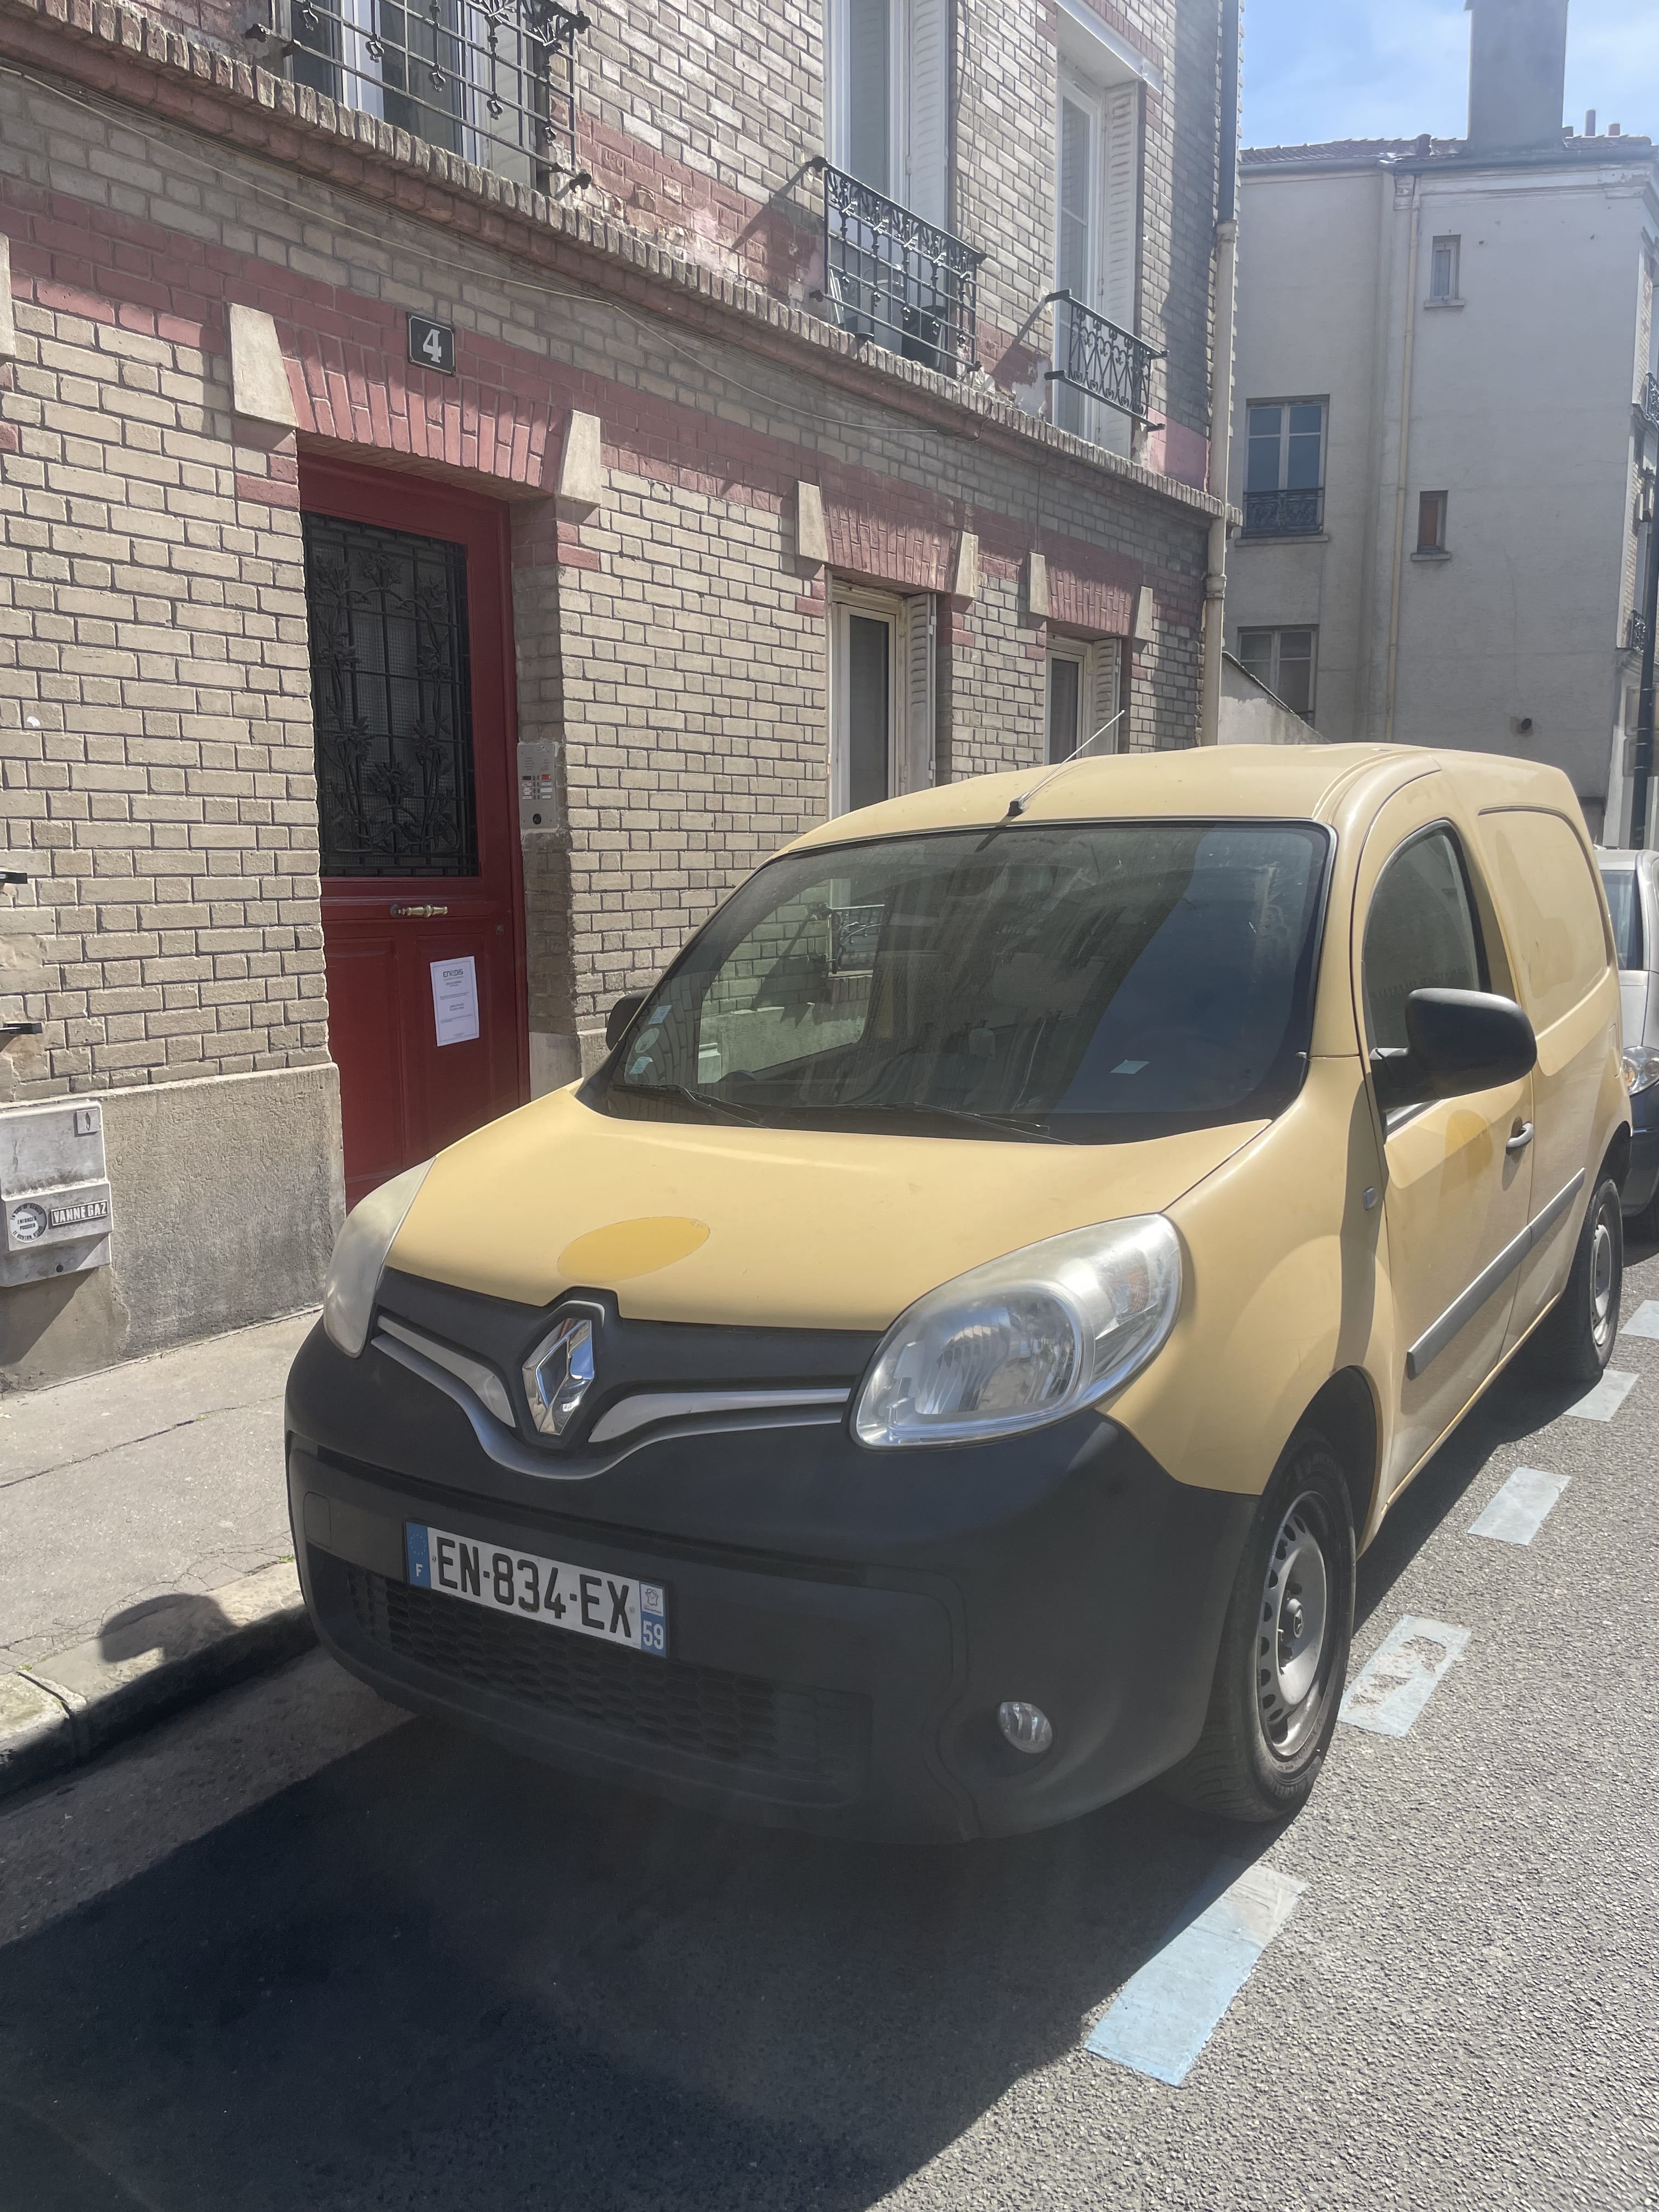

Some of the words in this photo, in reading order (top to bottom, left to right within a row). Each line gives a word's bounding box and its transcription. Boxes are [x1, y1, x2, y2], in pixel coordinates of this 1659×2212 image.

[423, 329, 442, 363] 4
[53, 1207, 86, 1223] VANNE
[87, 1202, 106, 1217] GAZ
[416, 1564, 423, 1577] F
[437, 1536, 631, 1638] EN-834-EX
[643, 1620, 664, 1650] 59
